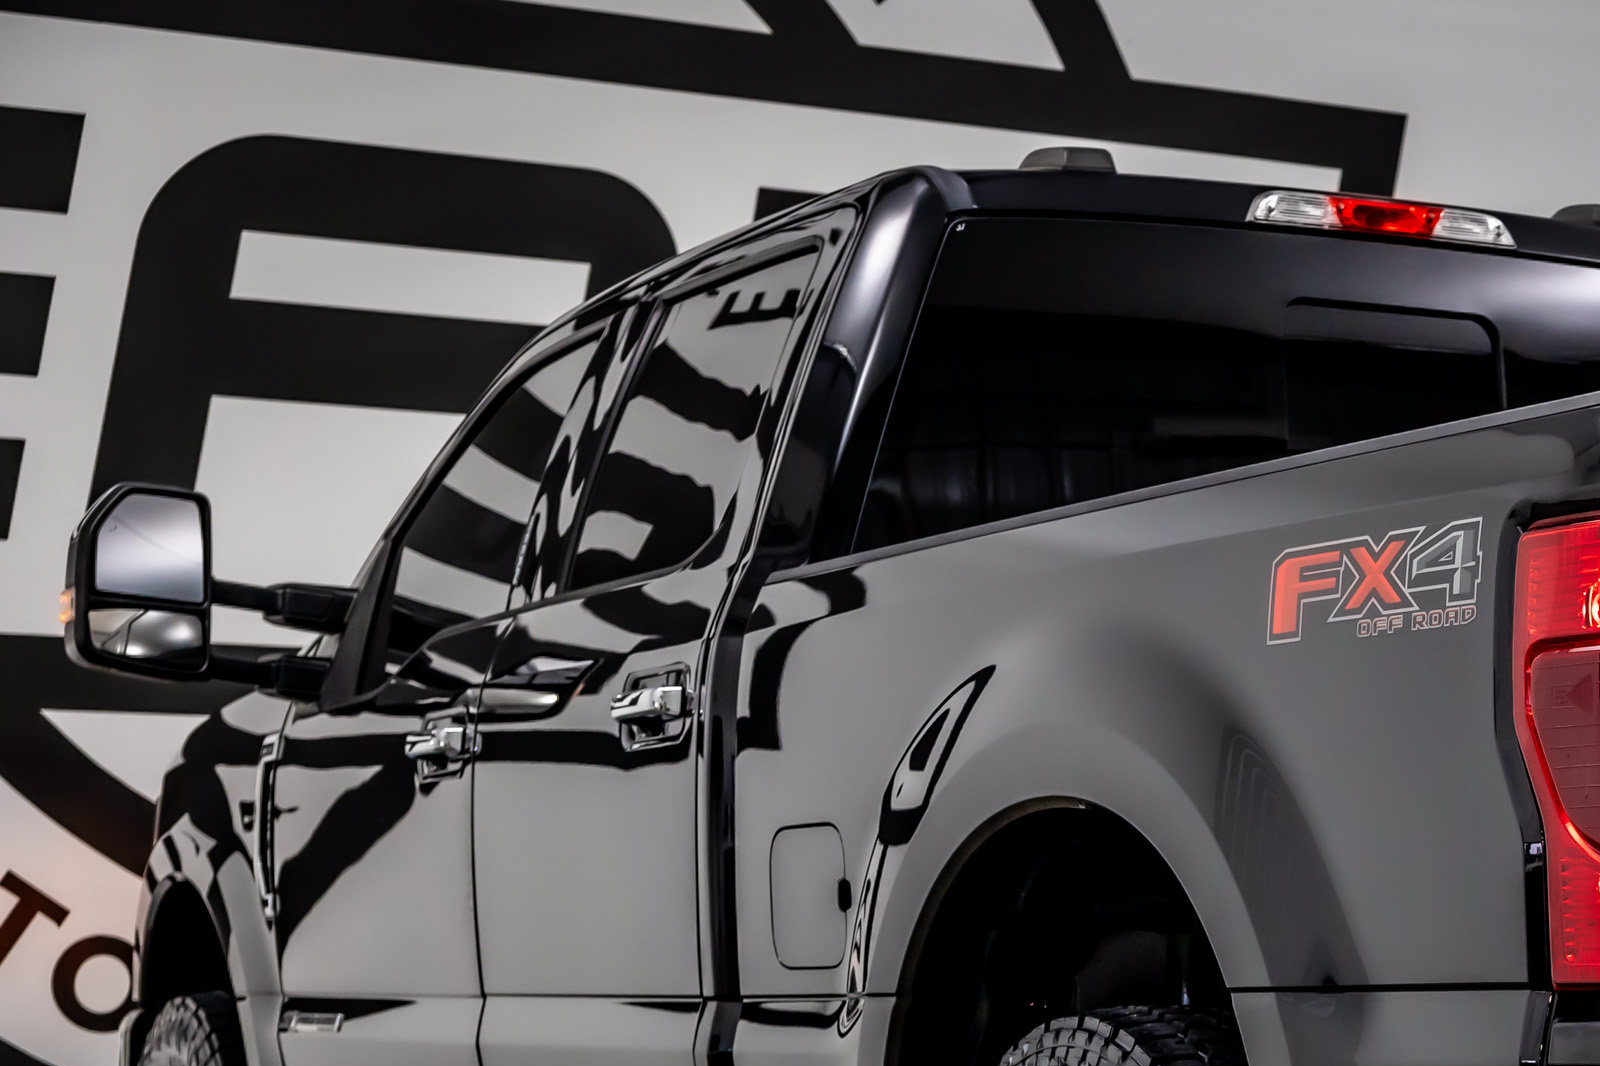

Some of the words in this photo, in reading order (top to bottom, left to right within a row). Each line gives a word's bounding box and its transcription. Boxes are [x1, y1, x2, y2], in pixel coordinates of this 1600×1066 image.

[1267, 516, 1483, 645] FX4
[1356, 614, 1403, 637] OFF
[1411, 604, 1477, 631] ROAD
